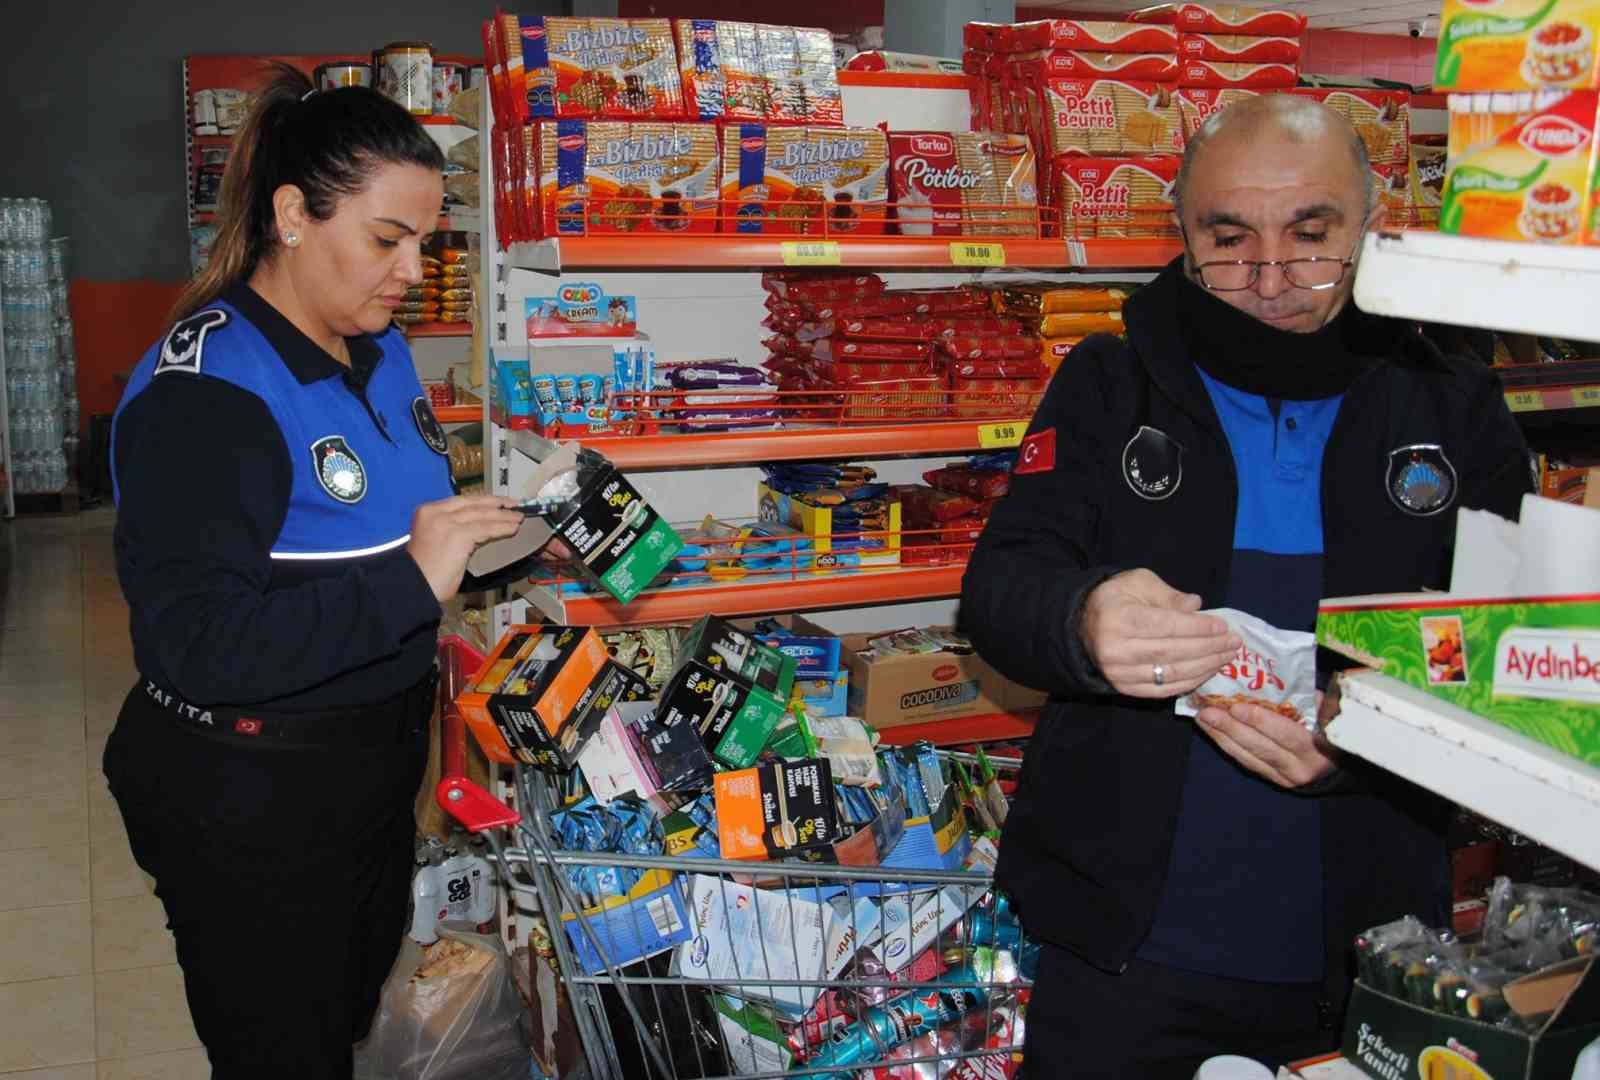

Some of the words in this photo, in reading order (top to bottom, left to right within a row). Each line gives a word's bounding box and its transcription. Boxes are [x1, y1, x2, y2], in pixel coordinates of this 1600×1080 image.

[1066, 97, 1113, 115] Petit
[1058, 113, 1115, 128] Beurre
[607, 134, 692, 164] Bizbize
[784, 138, 865, 166] Bizbize
[917, 138, 948, 151] Torku
[898, 156, 980, 189] Pötibör
[1082, 184, 1129, 203] Petit
